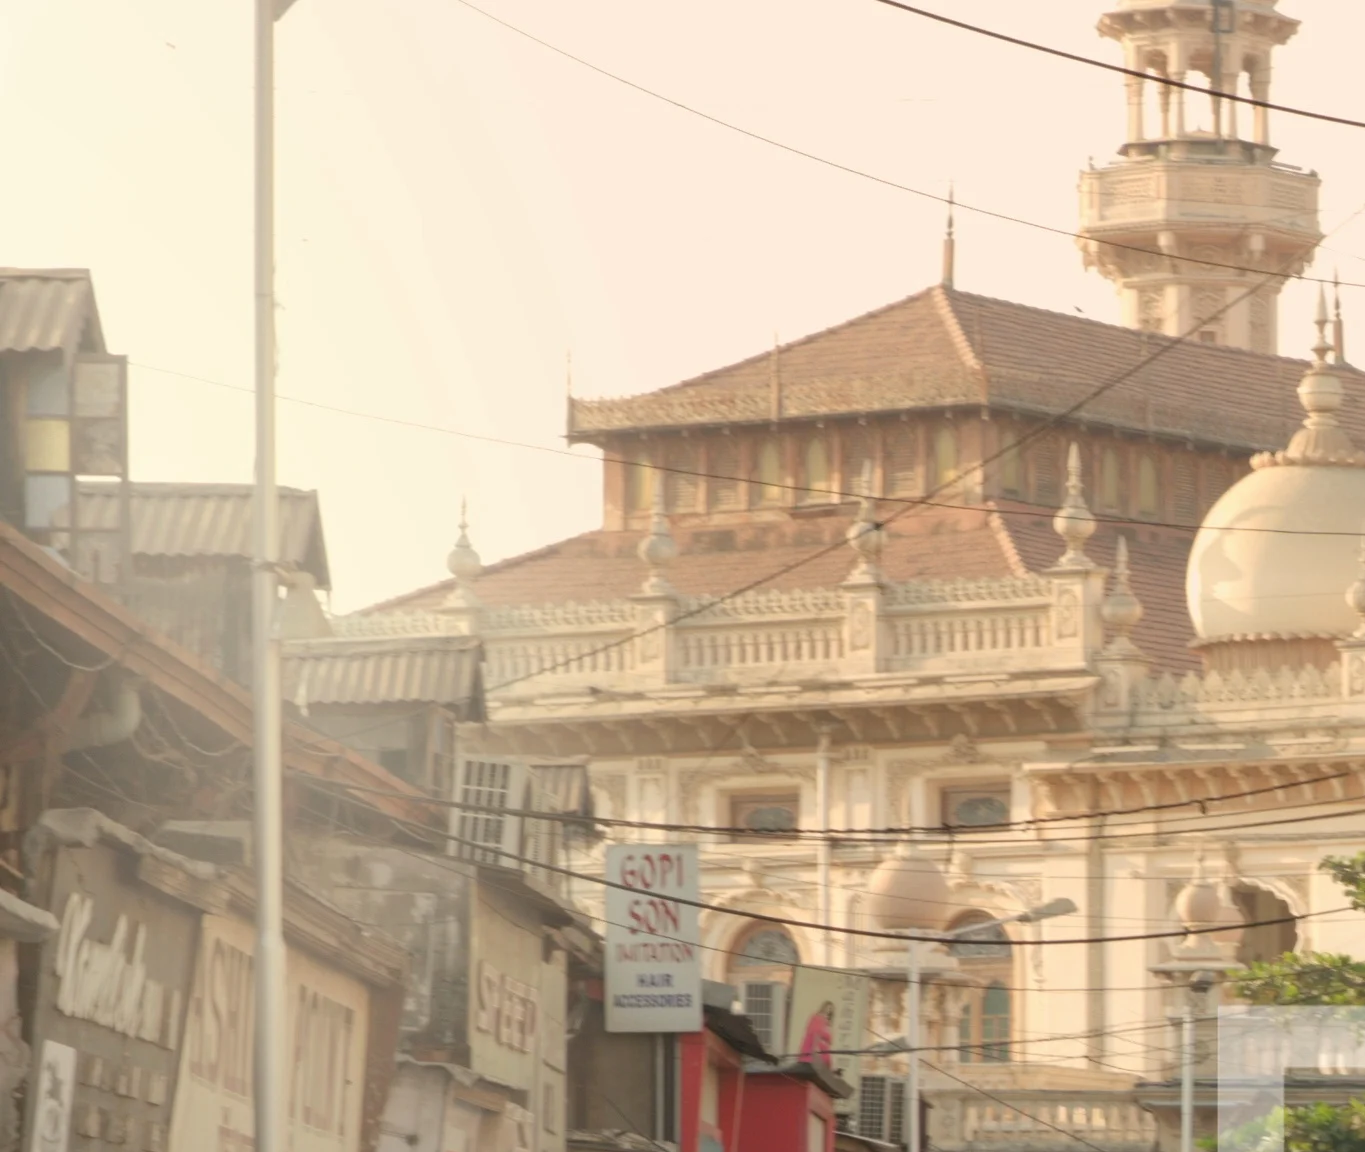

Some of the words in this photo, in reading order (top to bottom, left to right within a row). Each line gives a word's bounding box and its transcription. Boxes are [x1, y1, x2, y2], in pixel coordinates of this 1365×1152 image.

[620, 853, 685, 890] GOPI
[627, 898, 682, 935] SON
[637, 973, 673, 989] HAIR
[613, 993, 693, 1009] ACCESSORIES
